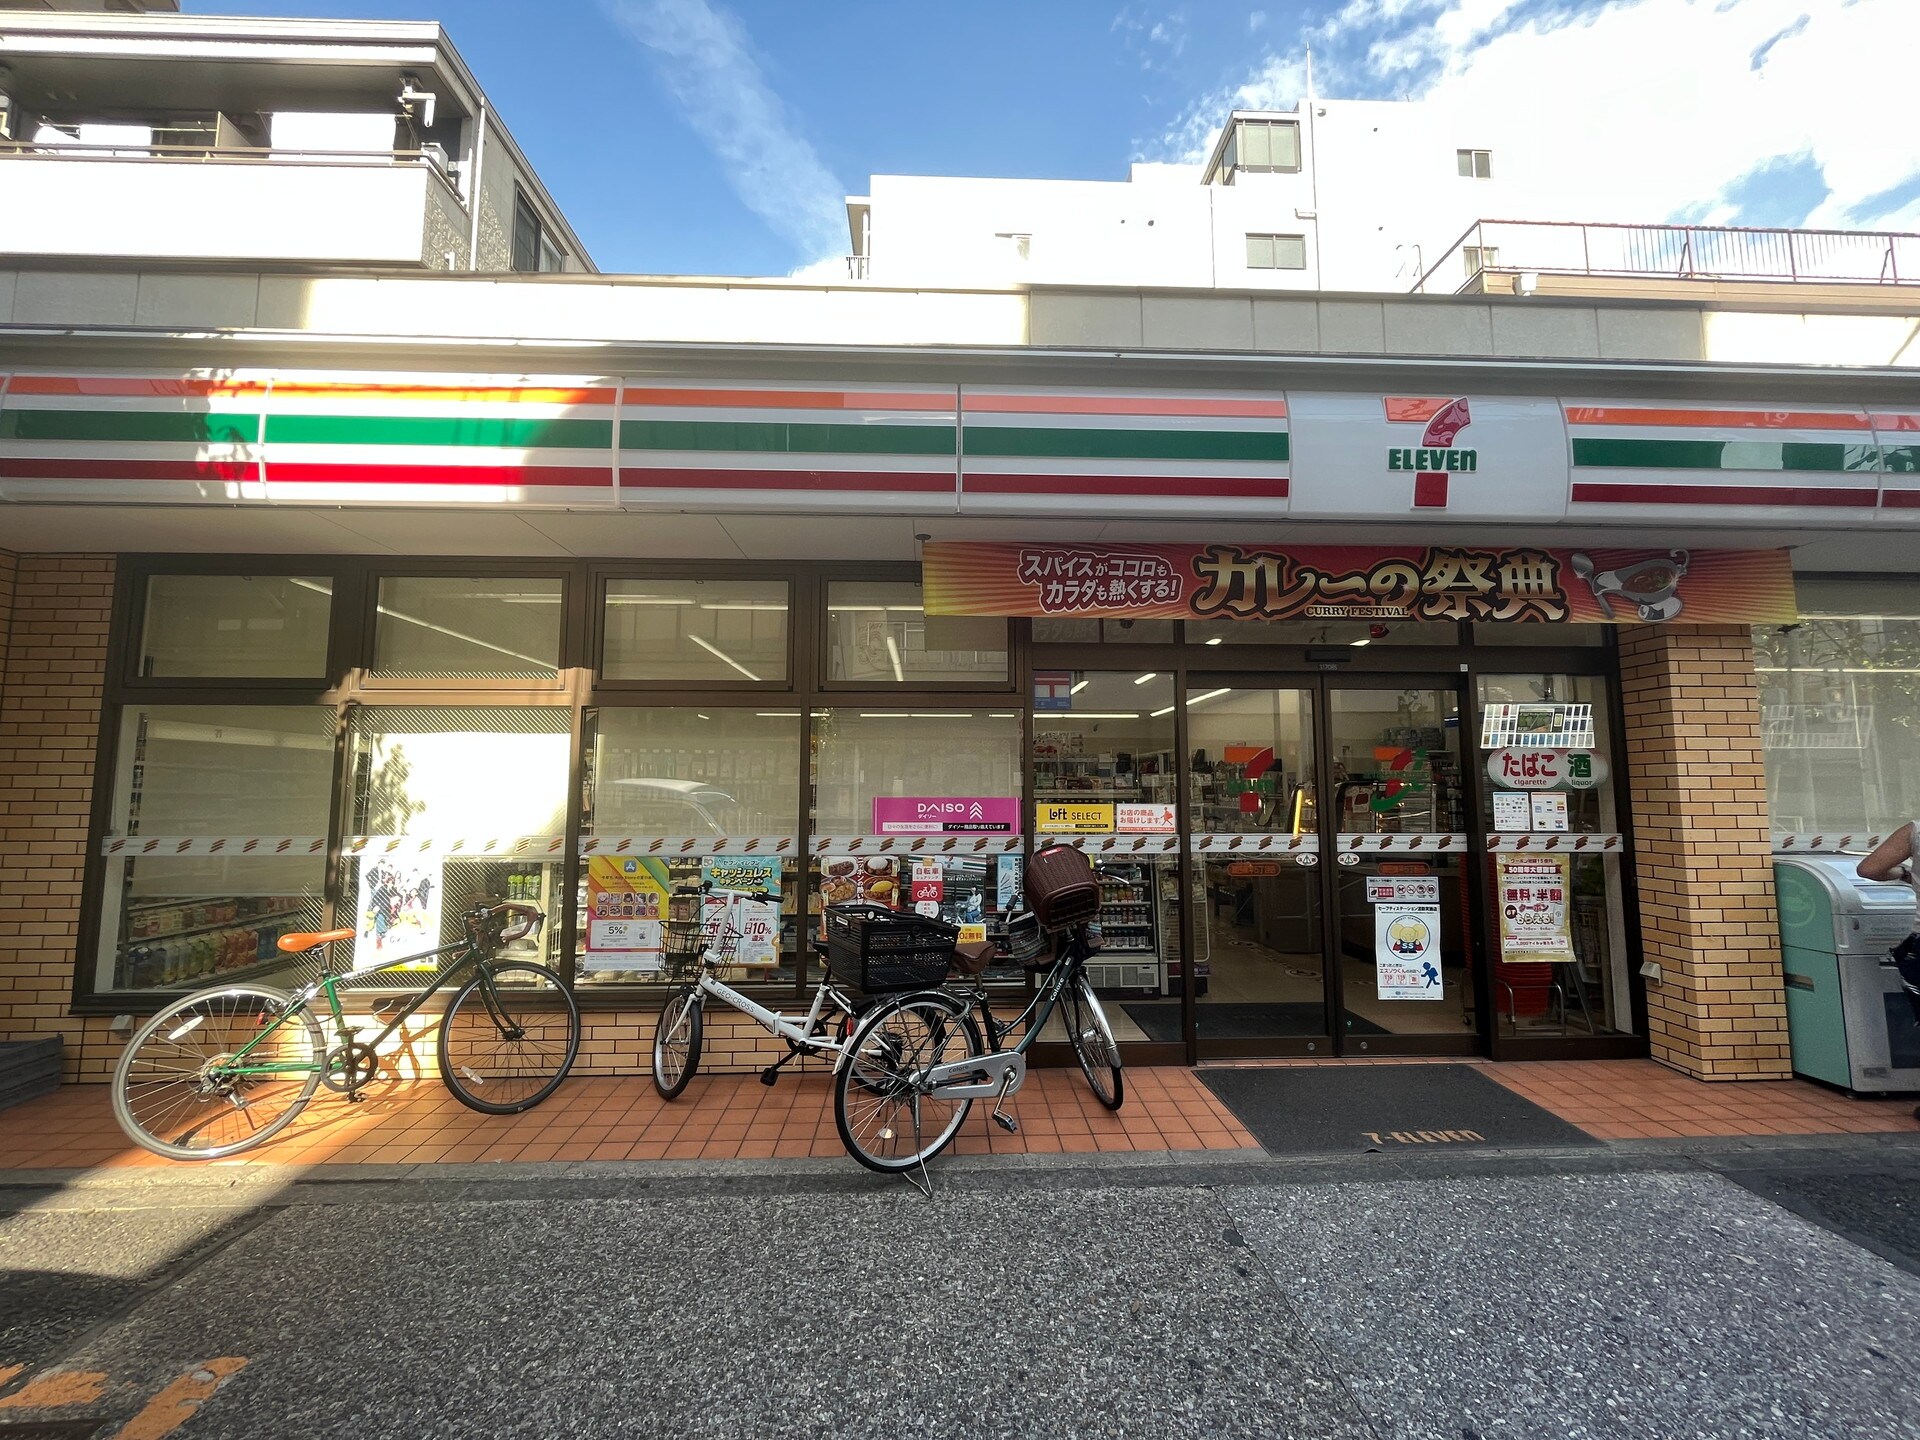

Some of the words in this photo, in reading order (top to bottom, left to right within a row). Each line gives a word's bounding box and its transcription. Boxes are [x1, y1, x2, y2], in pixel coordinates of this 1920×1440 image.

[1024, 555, 1168, 578] スパイスがココロも
[1194, 550, 1566, 621] カレーの祭典
[1305, 606, 1347, 617] CURRY
[1350, 606, 1409, 617] FESTIVAL
[1502, 752, 1558, 778] たばこ
[1567, 753, 1592, 778] 酒
[917, 803, 965, 813] DAISO
[1071, 811, 1102, 820] SELECT
[711, 867, 772, 878] キャッシュレス
[916, 867, 939, 875] 自転車
[719, 878, 754, 886] キャンペーン
[608, 926, 623, 935] 5%
[753, 922, 772, 935] 10%
[1050, 977, 1064, 1001] Colore
